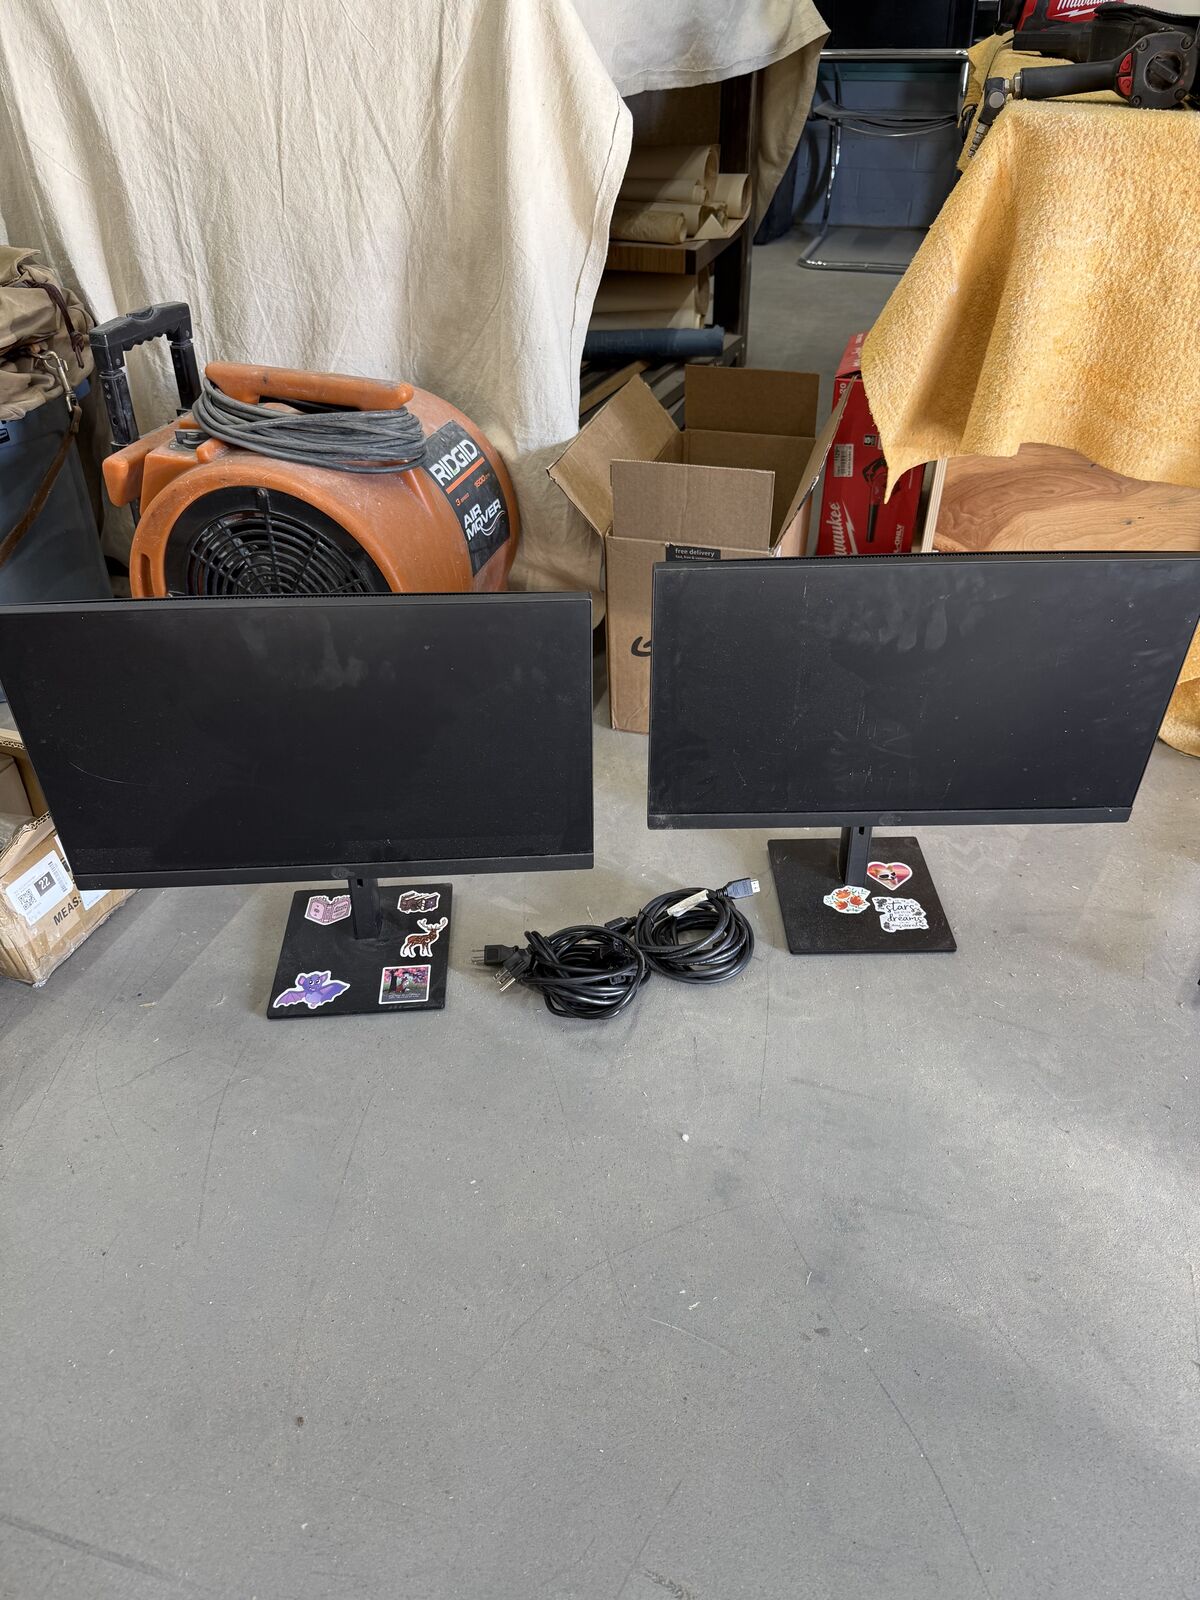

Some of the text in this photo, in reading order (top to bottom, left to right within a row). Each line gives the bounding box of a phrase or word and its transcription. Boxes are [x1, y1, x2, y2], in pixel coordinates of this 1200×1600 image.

[429, 439, 479, 487] RIDGID
[464, 503, 482, 528] AIR
[465, 498, 502, 540] MOVER
[826, 501, 847, 555] waukee
[689, 549, 715, 557] delivery
[38, 877, 51, 890] 22
[885, 901, 915, 913] stars
[887, 914, 922, 923] dreams
